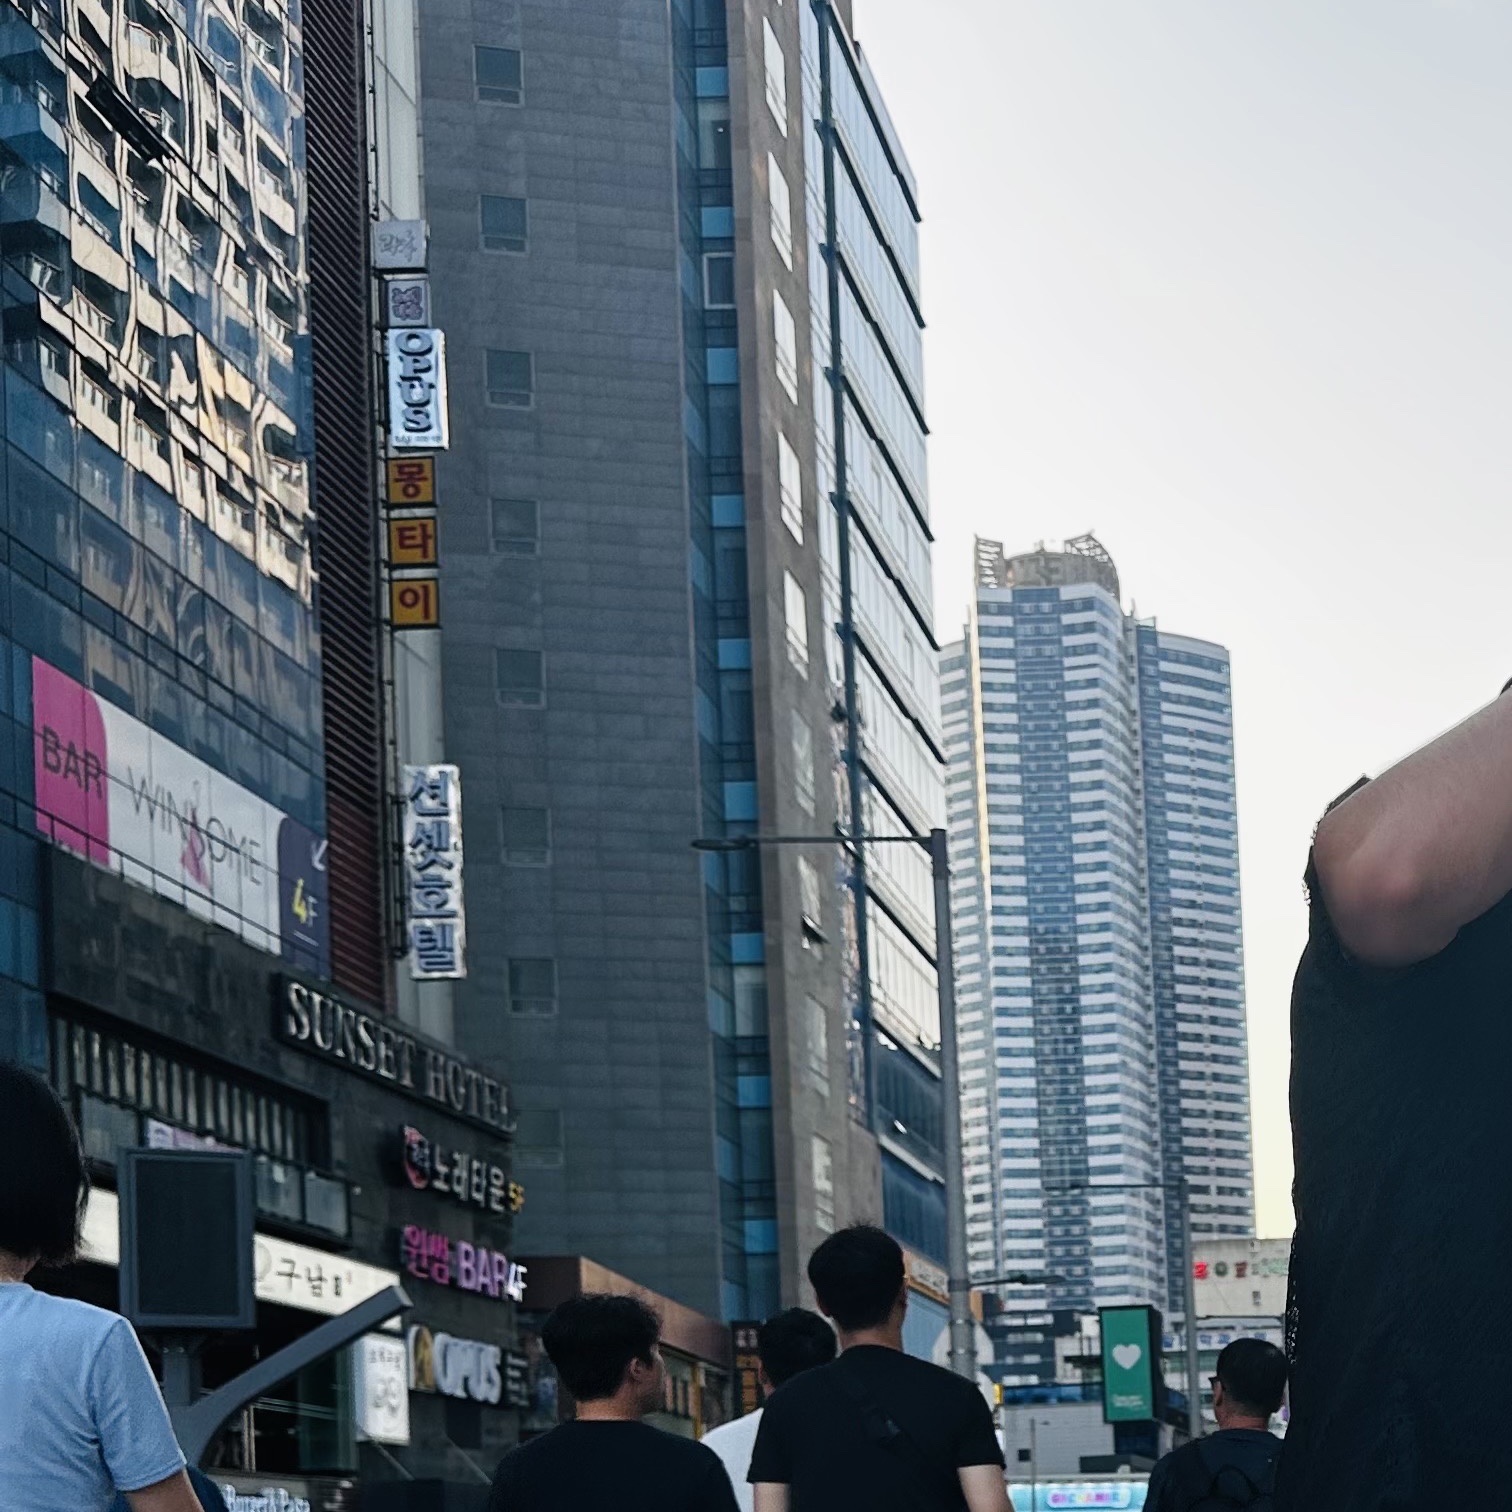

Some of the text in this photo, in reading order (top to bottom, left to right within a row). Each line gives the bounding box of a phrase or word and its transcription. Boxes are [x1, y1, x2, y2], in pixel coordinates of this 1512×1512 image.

[396, 332, 434, 433] OPUS
[42, 725, 103, 800] BAR
[410, 770, 458, 972] 선셋호텔
[288, 981, 518, 1133] SUNSET HOTEL
[455, 1240, 508, 1297] BAR
